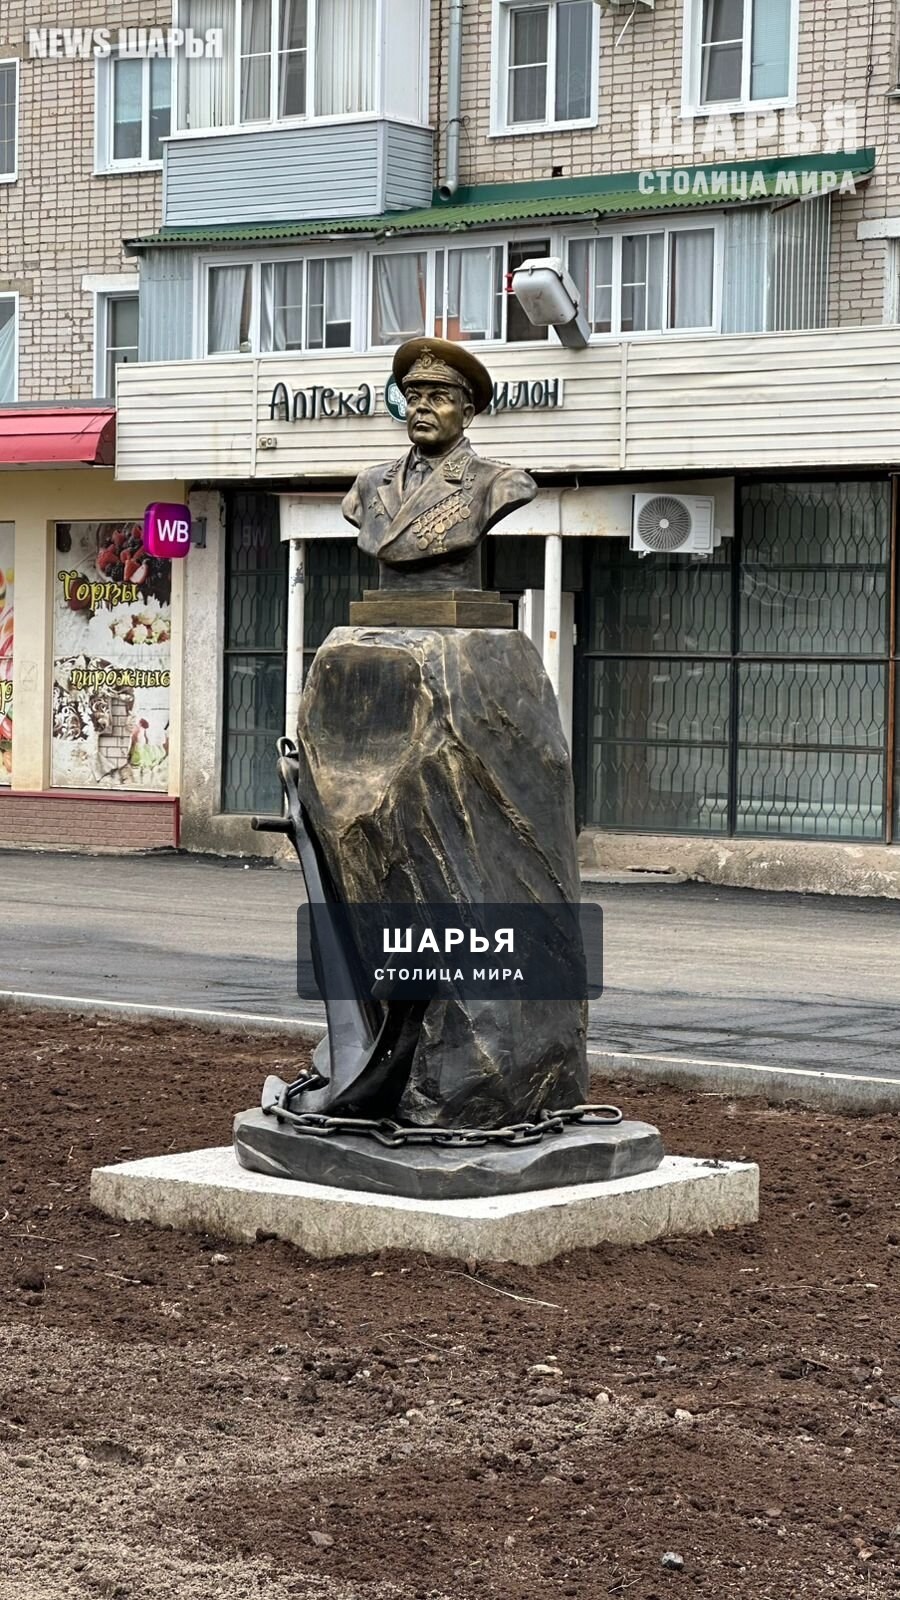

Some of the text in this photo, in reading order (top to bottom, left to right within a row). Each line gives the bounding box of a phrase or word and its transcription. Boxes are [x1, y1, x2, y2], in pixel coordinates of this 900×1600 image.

[268, 378, 562, 421] Аптека илон
[157, 518, 189, 543] WB
[58, 570, 139, 611] Торты
[71, 668, 170, 694] пирожные
